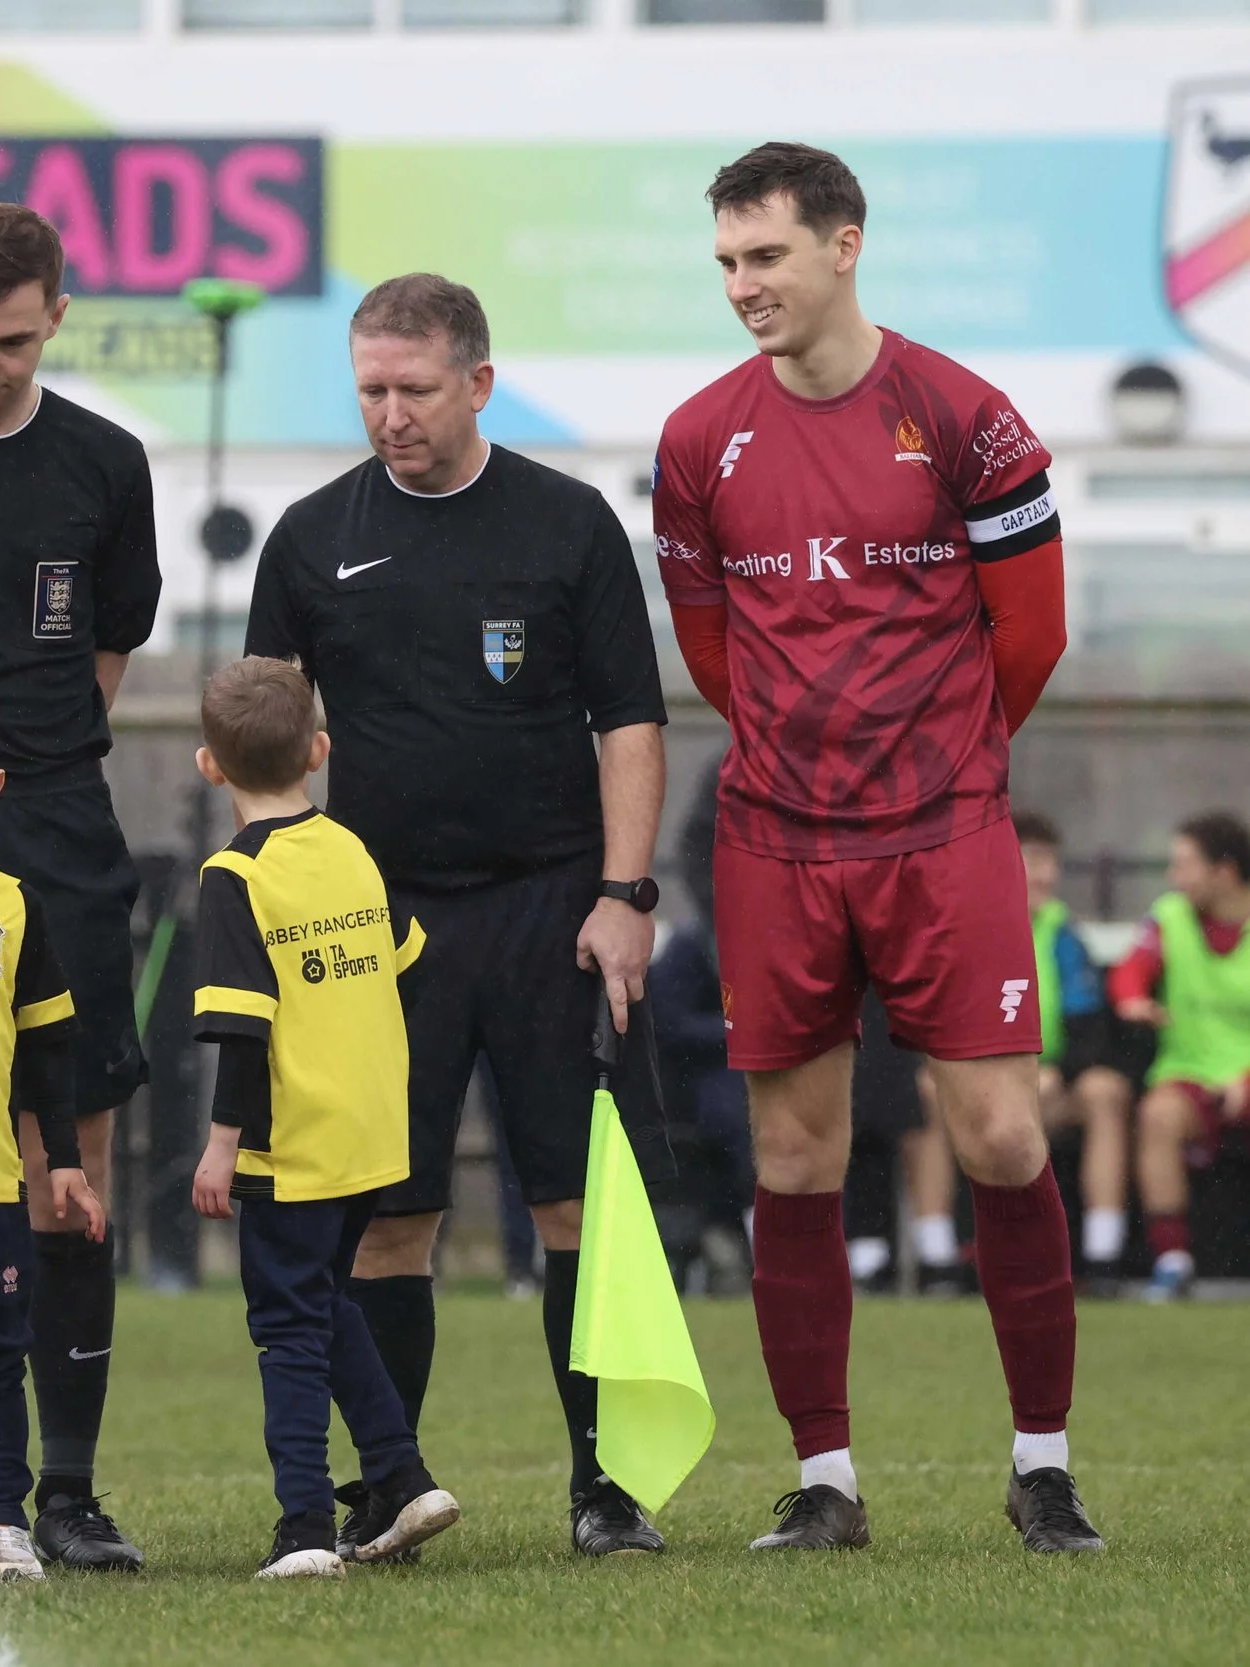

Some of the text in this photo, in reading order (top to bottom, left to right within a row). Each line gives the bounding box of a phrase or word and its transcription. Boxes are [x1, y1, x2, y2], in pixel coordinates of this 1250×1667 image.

[1001, 497, 1050, 532] CAPTAIN
[806, 536, 851, 581] K
[864, 541, 955, 565] Estates
[329, 943, 347, 962] TA
[333, 954, 379, 980] SPORTS
